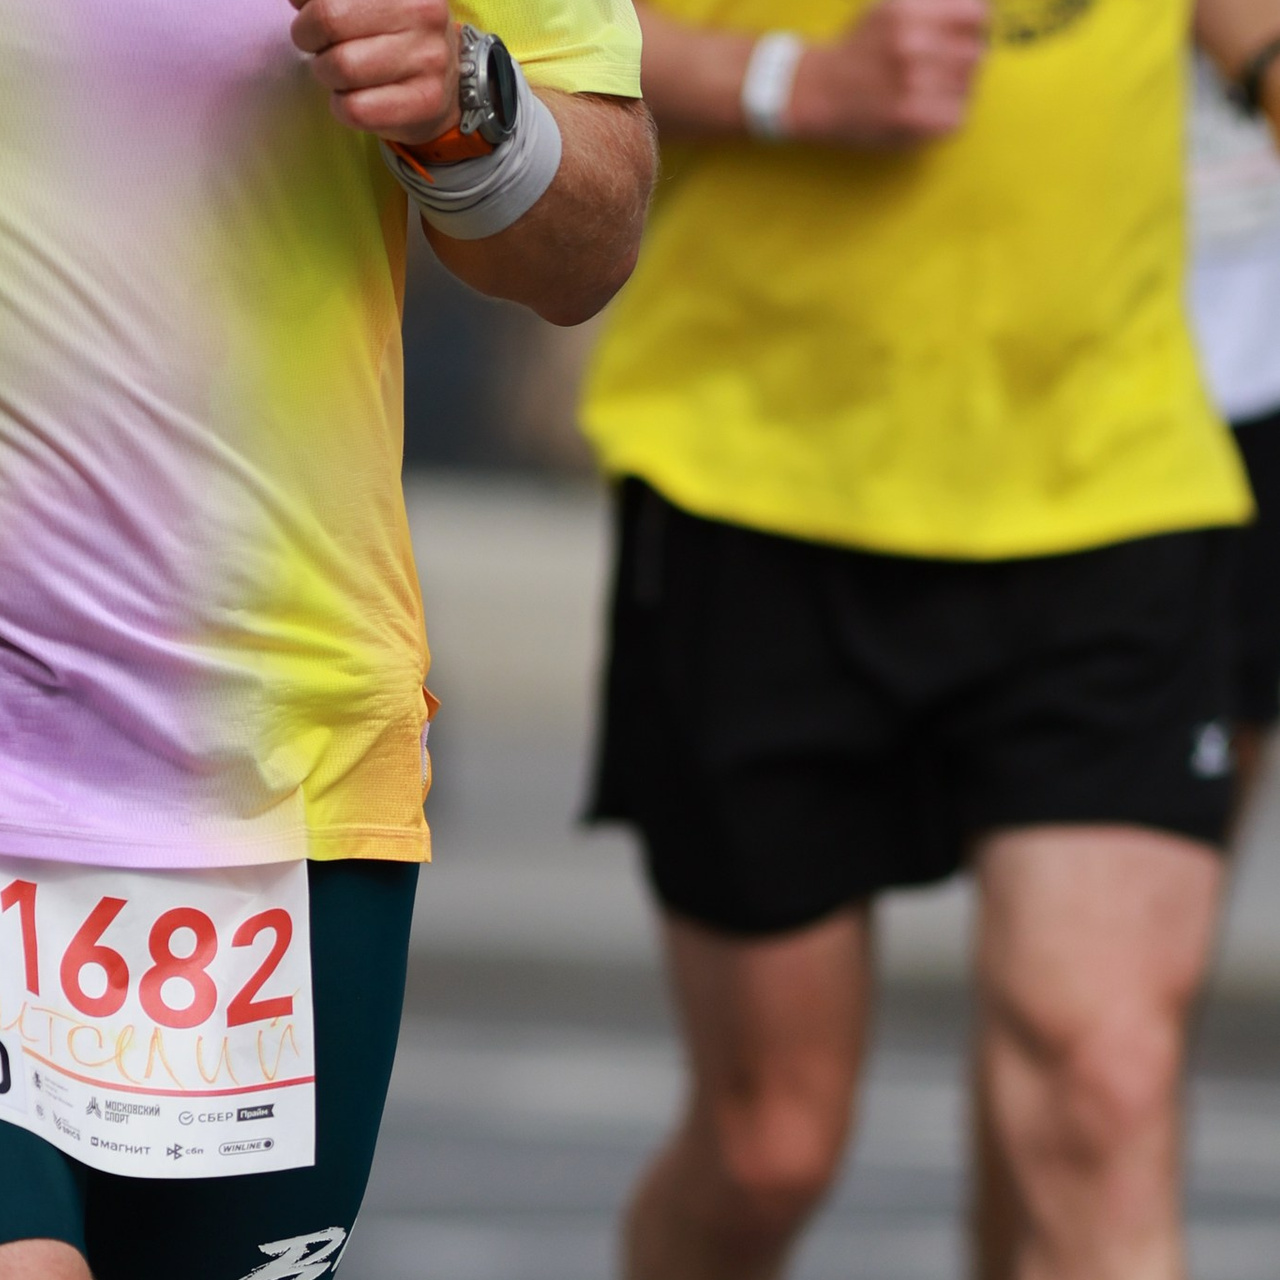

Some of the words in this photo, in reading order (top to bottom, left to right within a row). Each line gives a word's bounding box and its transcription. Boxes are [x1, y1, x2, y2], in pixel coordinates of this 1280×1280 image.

[105, 1100, 161, 1117] МОСКОВСКИЙ
[104, 1112, 130, 1124] СПОРТ
[198, 1112, 234, 1123] СБЕР
[223, 1141, 262, 1153] WINLINE
